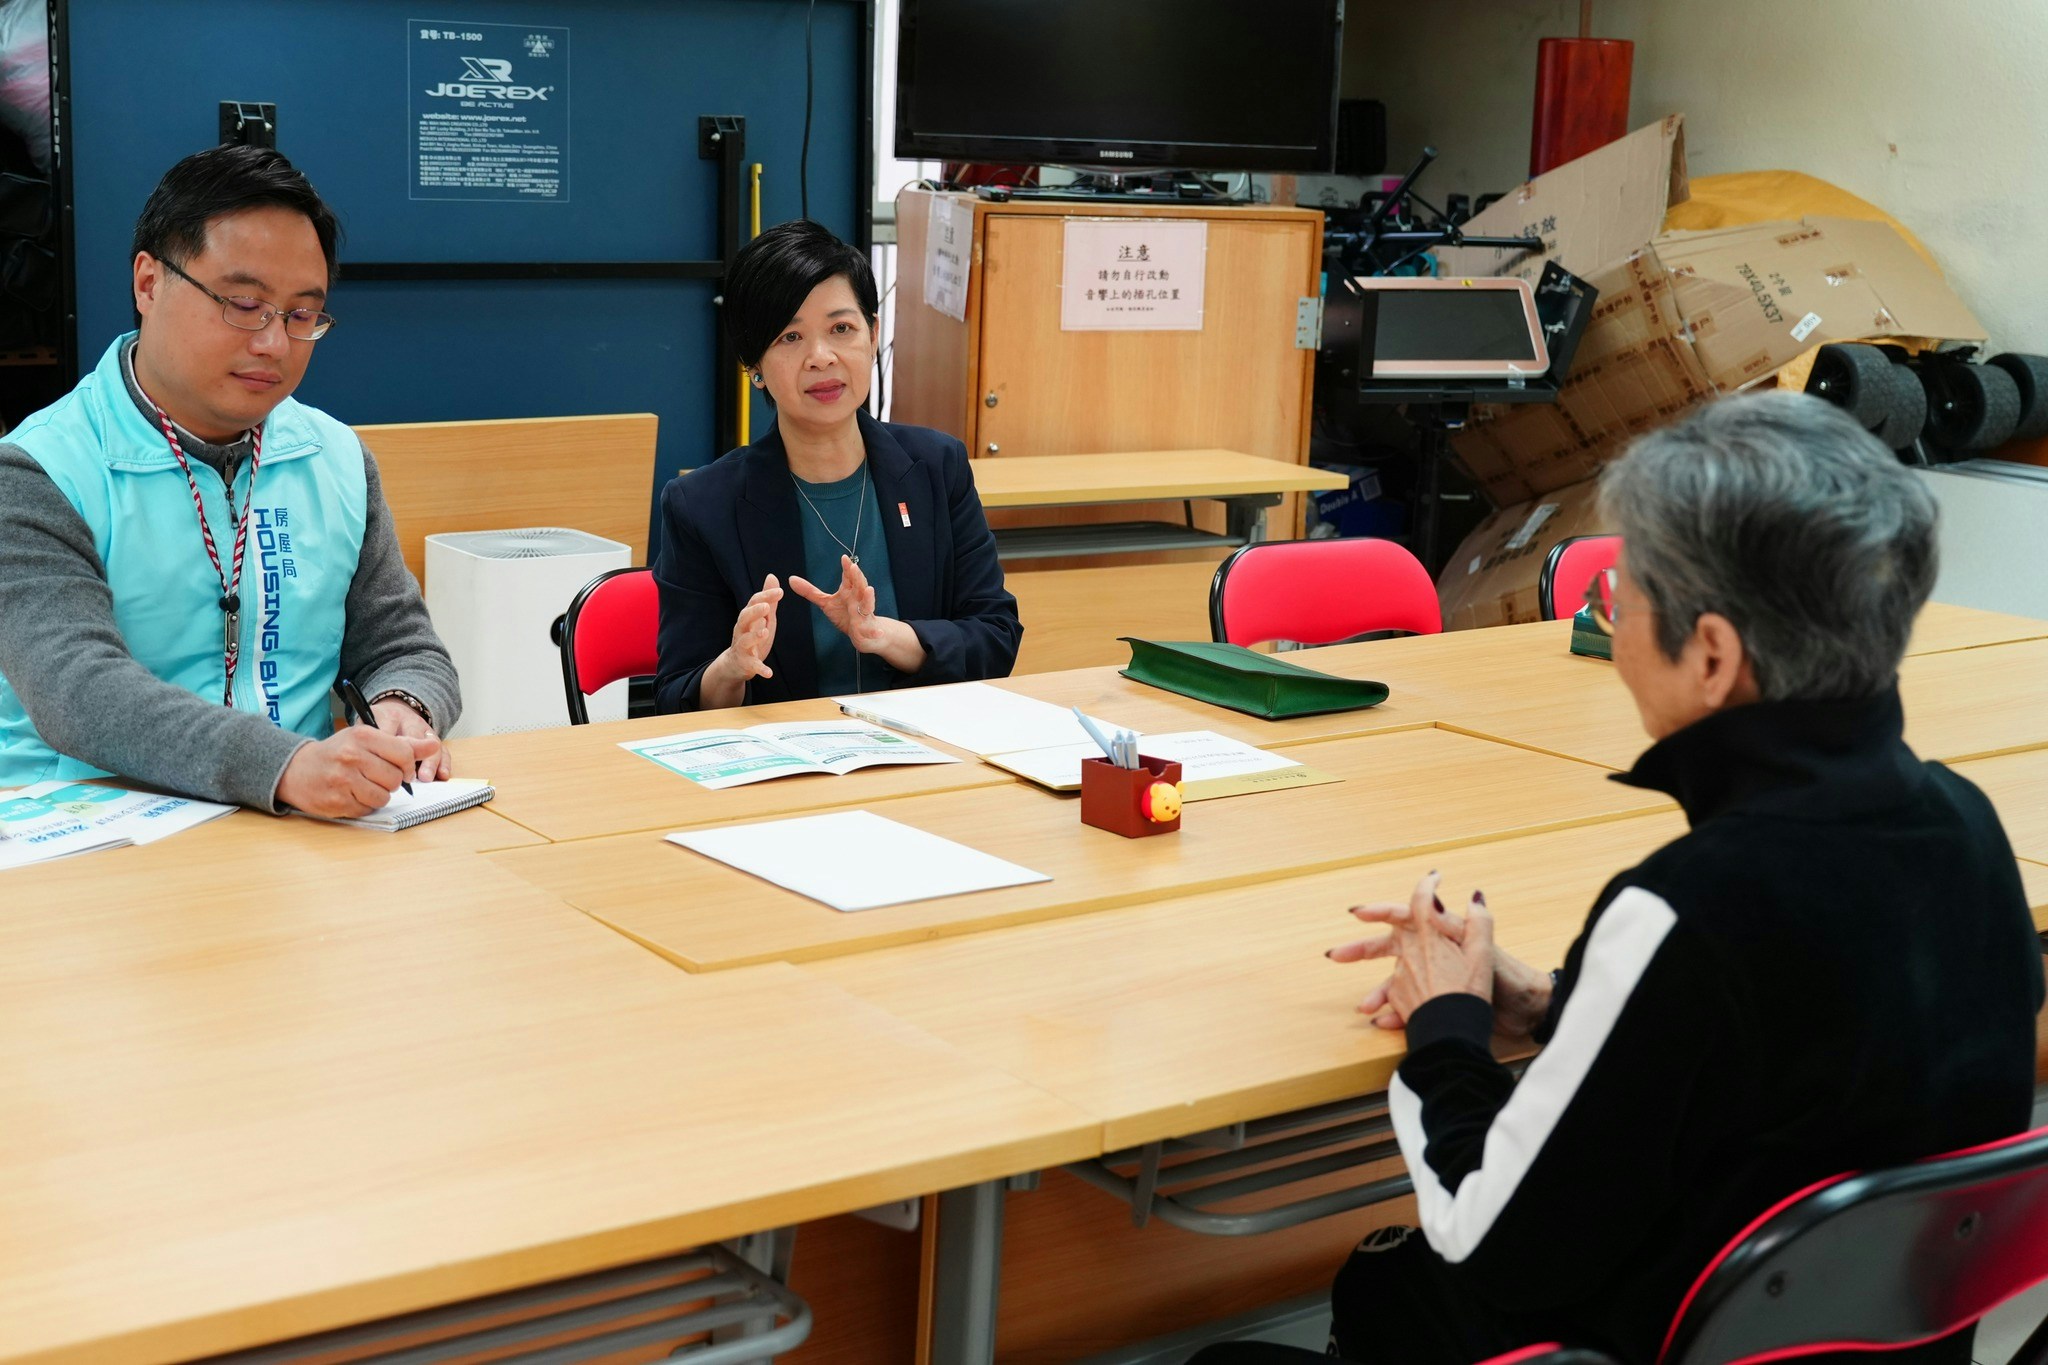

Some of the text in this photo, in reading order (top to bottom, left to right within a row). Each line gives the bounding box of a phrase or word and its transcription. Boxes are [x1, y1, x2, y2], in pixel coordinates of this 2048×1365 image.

[442, 31, 483, 41] TB-1500
[425, 83, 548, 101] JOEREX
[460, 114, 527, 122] www.joerex.net
[1099, 150, 1133, 158] SAMSUNG
[1118, 244, 1150, 261] 注意
[1098, 269, 1169, 281] 請勿自行改動
[275, 507, 297, 579] 房屋局
[253, 508, 282, 729] HOUSING BUR
